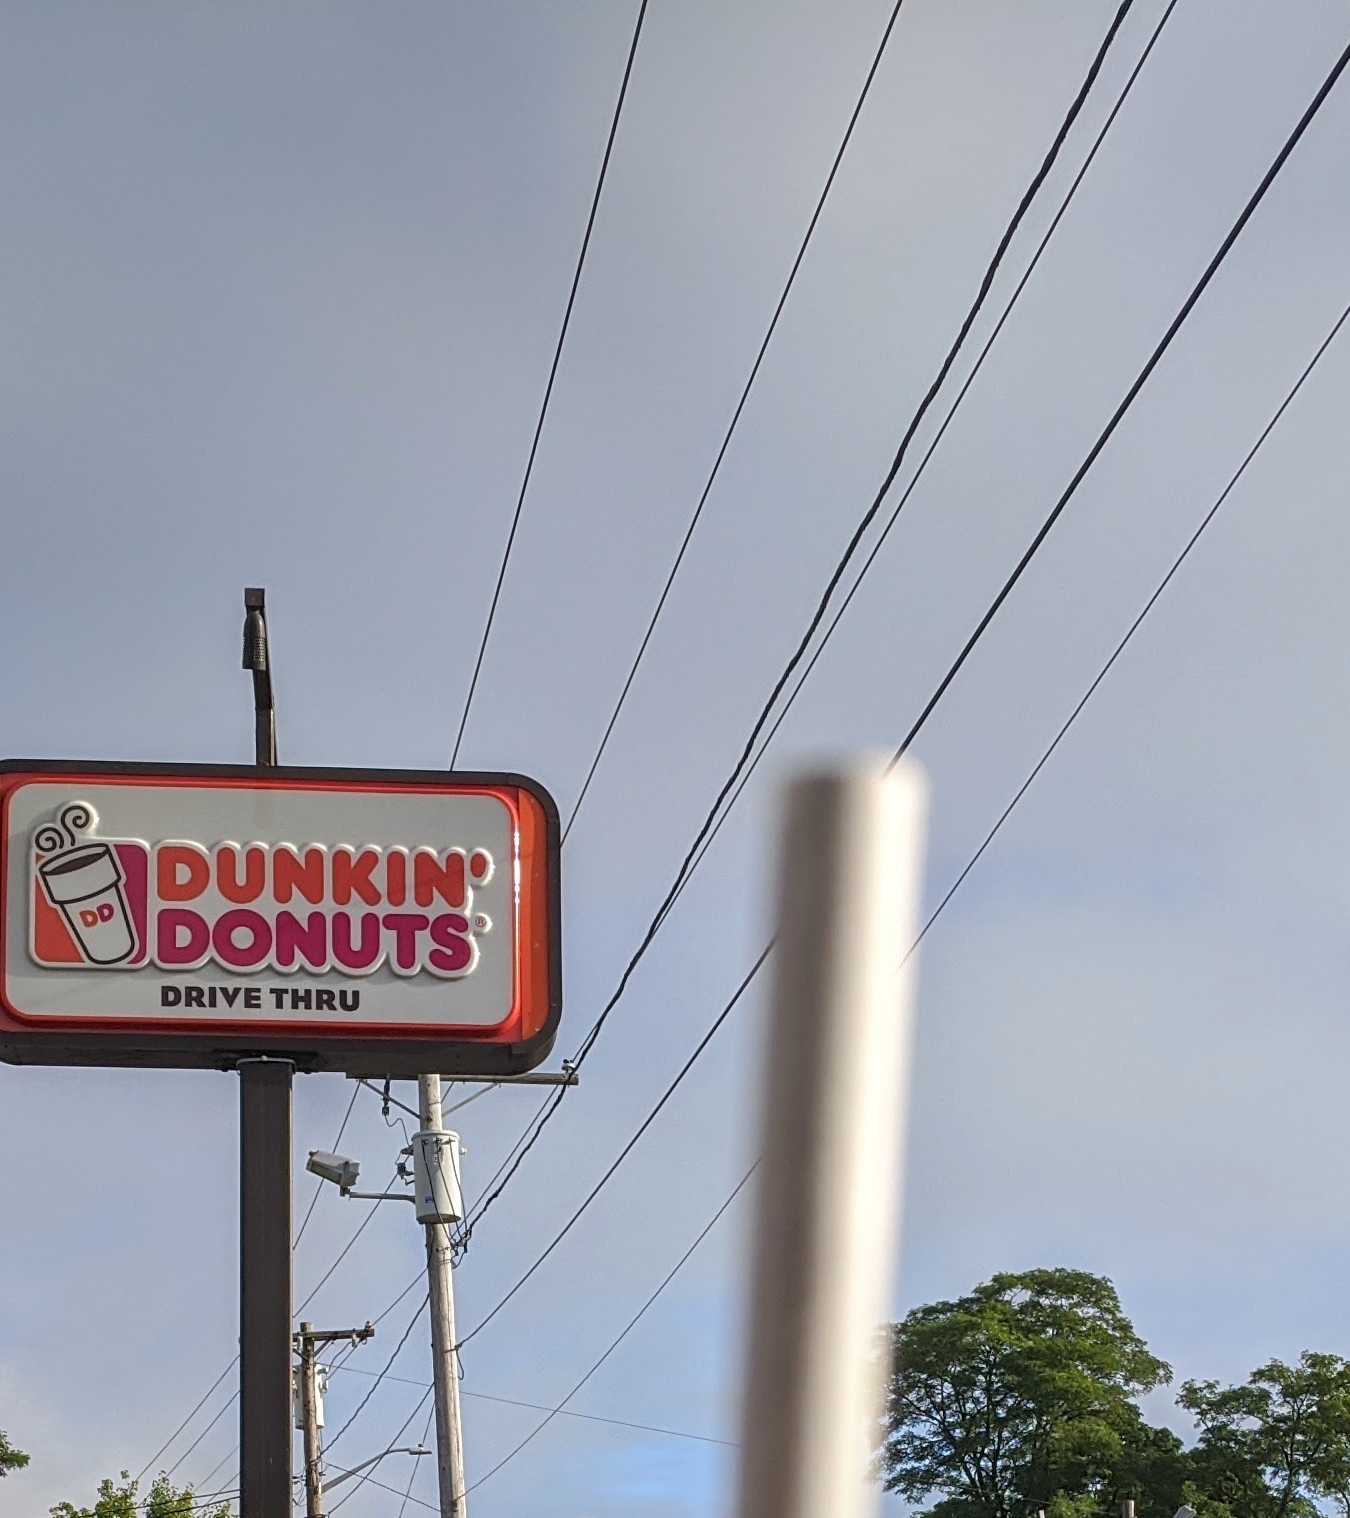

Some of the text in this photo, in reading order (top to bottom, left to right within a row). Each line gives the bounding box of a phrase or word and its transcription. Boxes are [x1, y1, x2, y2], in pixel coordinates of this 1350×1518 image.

[156, 846, 489, 909] DUNKIN'
[80, 903, 115, 929] DD
[156, 908, 473, 972] DONUTS
[160, 985, 361, 1012] DRIVE THRU
